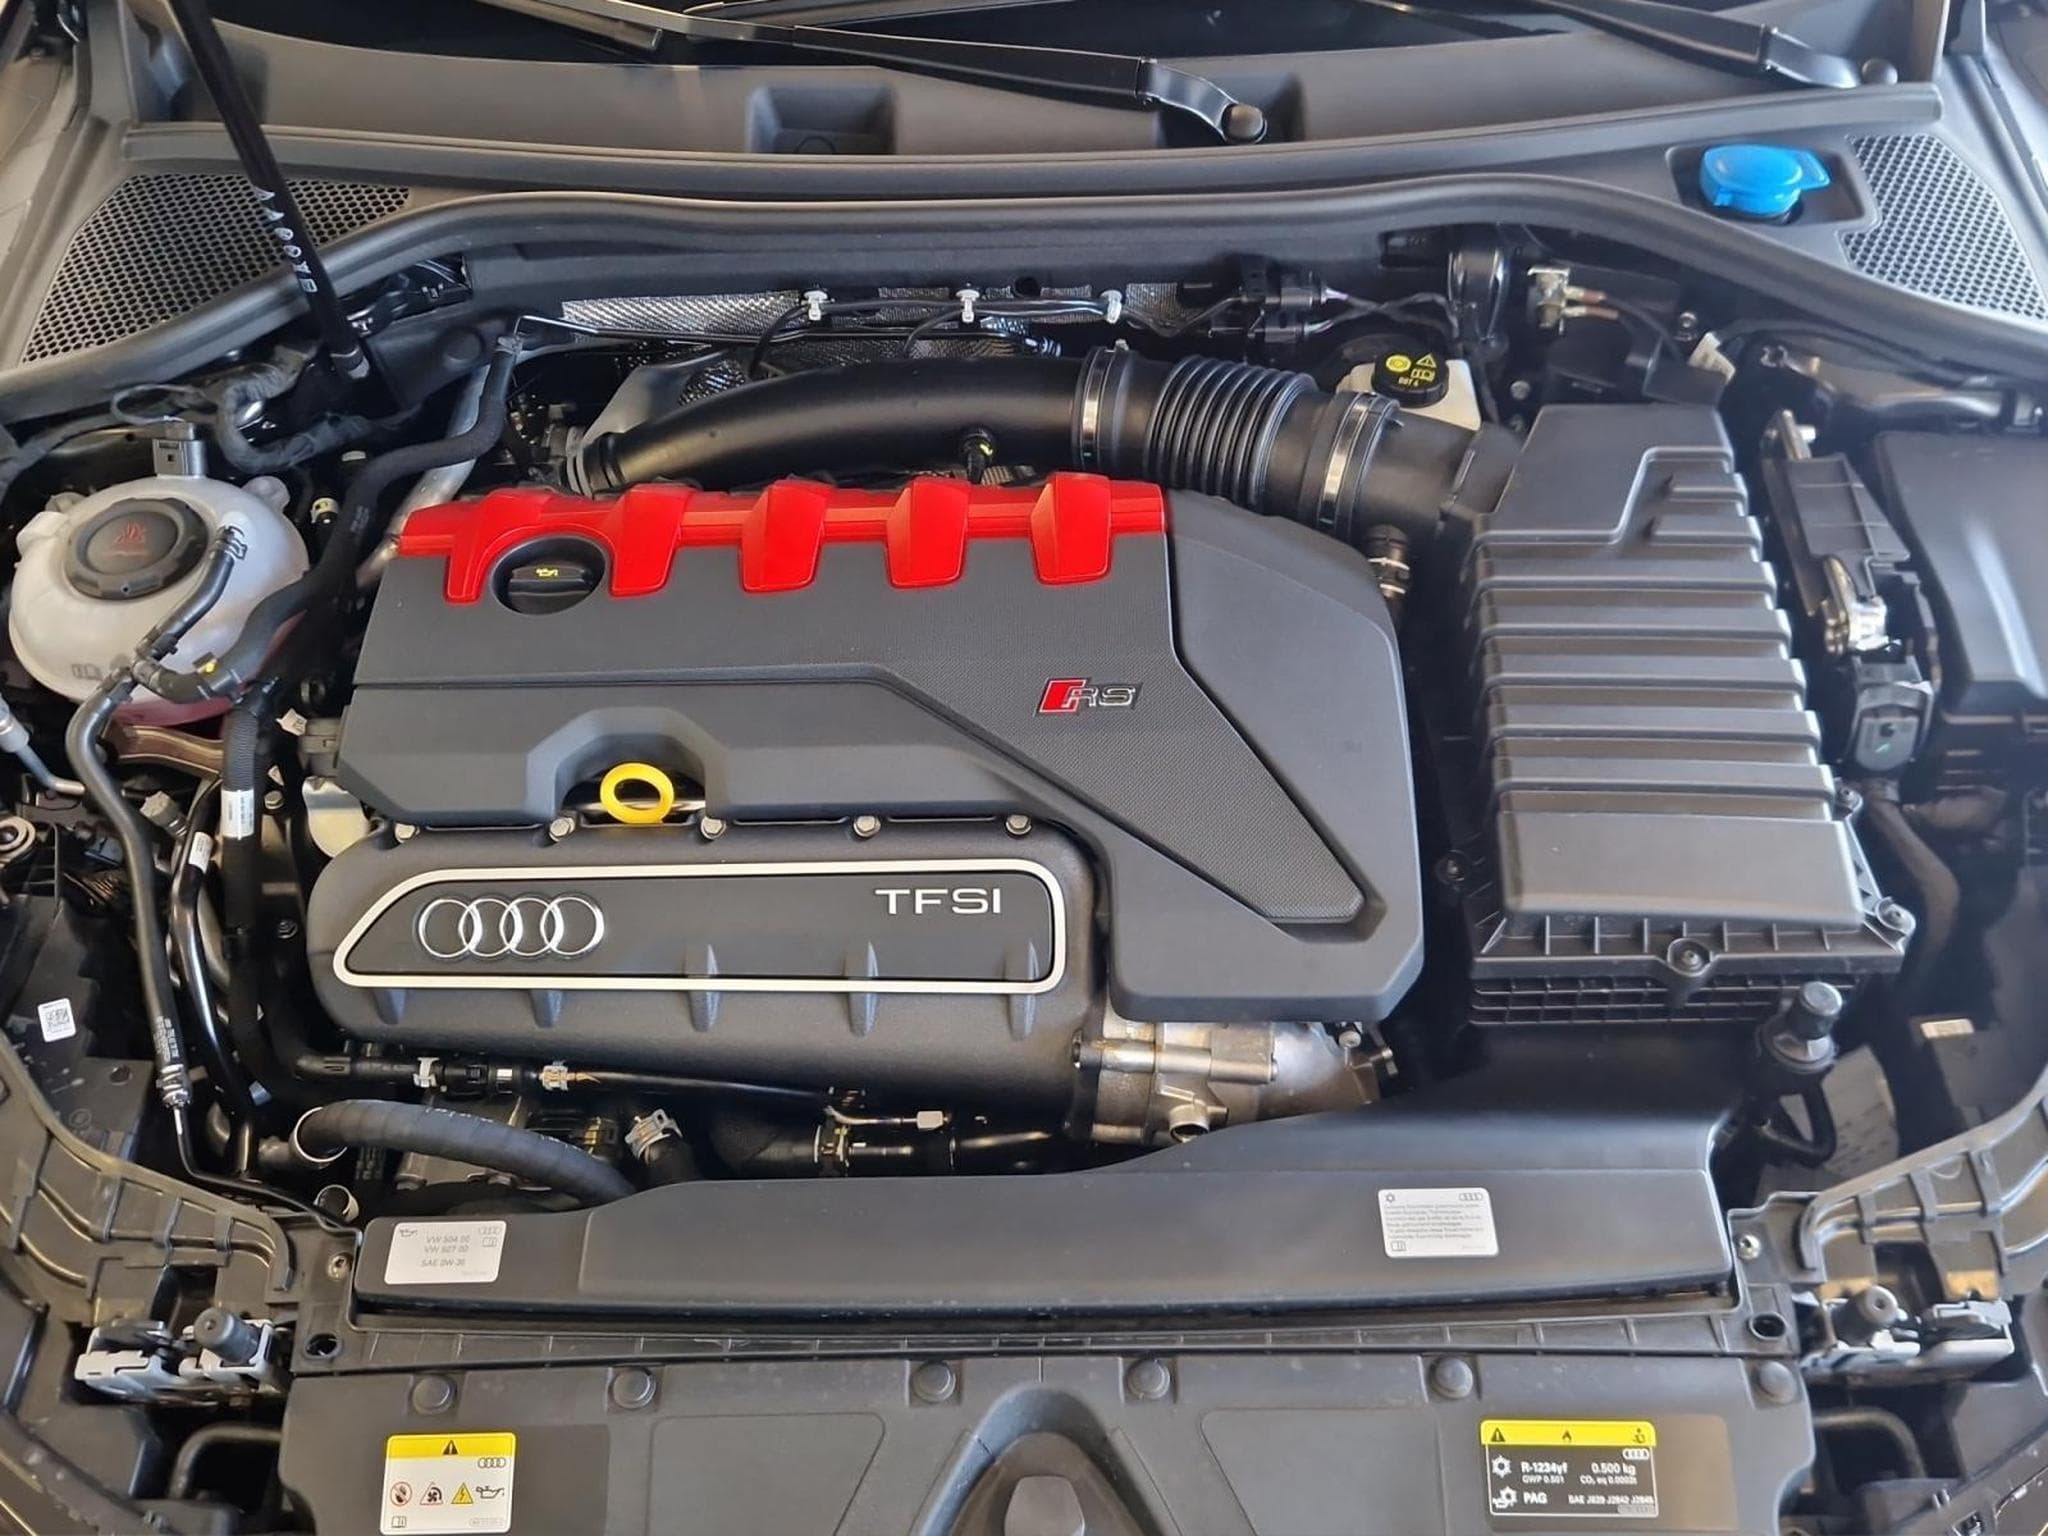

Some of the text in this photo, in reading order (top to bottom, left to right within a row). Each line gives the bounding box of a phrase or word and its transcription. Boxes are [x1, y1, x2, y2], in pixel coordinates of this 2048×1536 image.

[1055, 684, 1137, 709] RS
[875, 888, 1001, 915] TFSI
[1521, 1461, 1636, 1476] R-1234yf 0.500 kg
[1523, 1491, 1548, 1504] PAG
